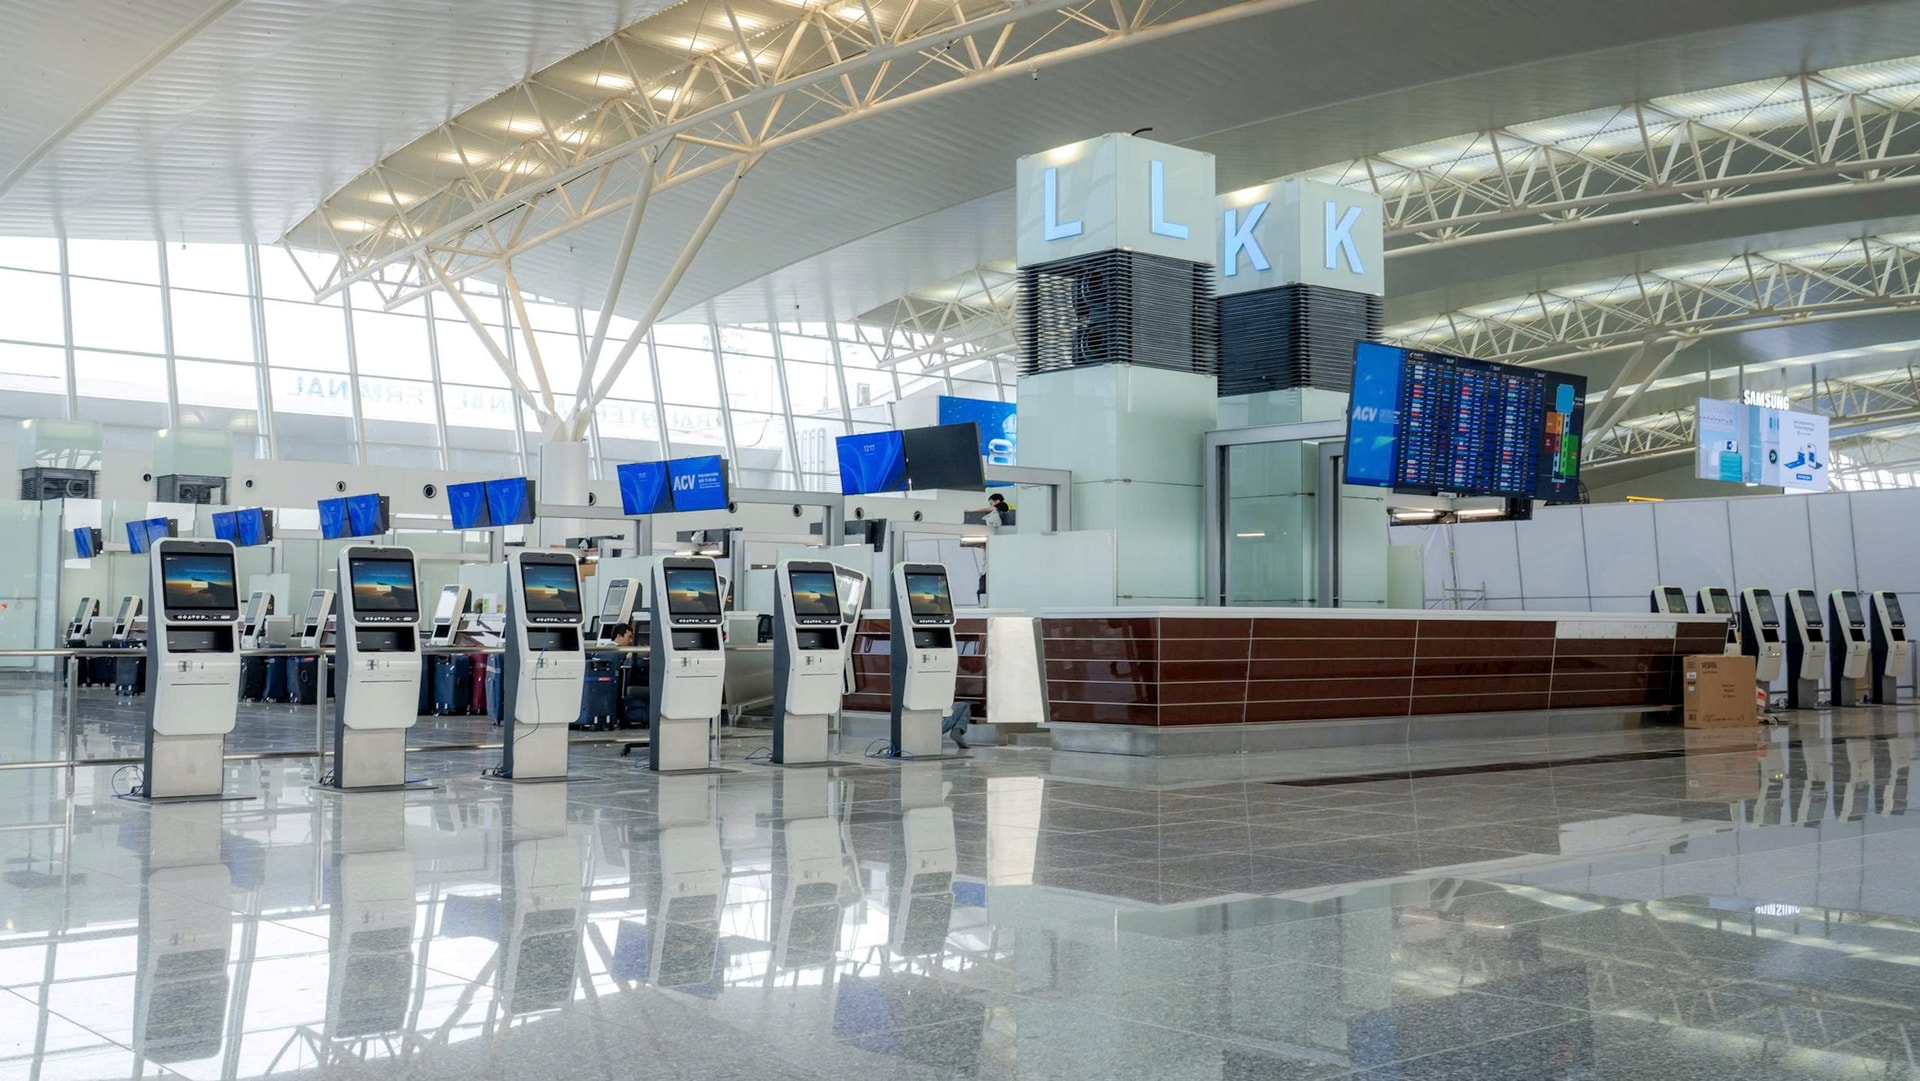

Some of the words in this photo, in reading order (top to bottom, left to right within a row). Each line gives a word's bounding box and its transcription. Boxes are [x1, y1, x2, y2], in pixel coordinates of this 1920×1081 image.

[1044, 167, 1083, 241] L
[1150, 160, 1189, 240] L
[1224, 201, 1271, 276] K
[1325, 201, 1365, 274] K
[1352, 405, 1378, 422] ACV
[1743, 389, 1790, 411] SAMSUNG
[673, 474, 695, 491] ACV
